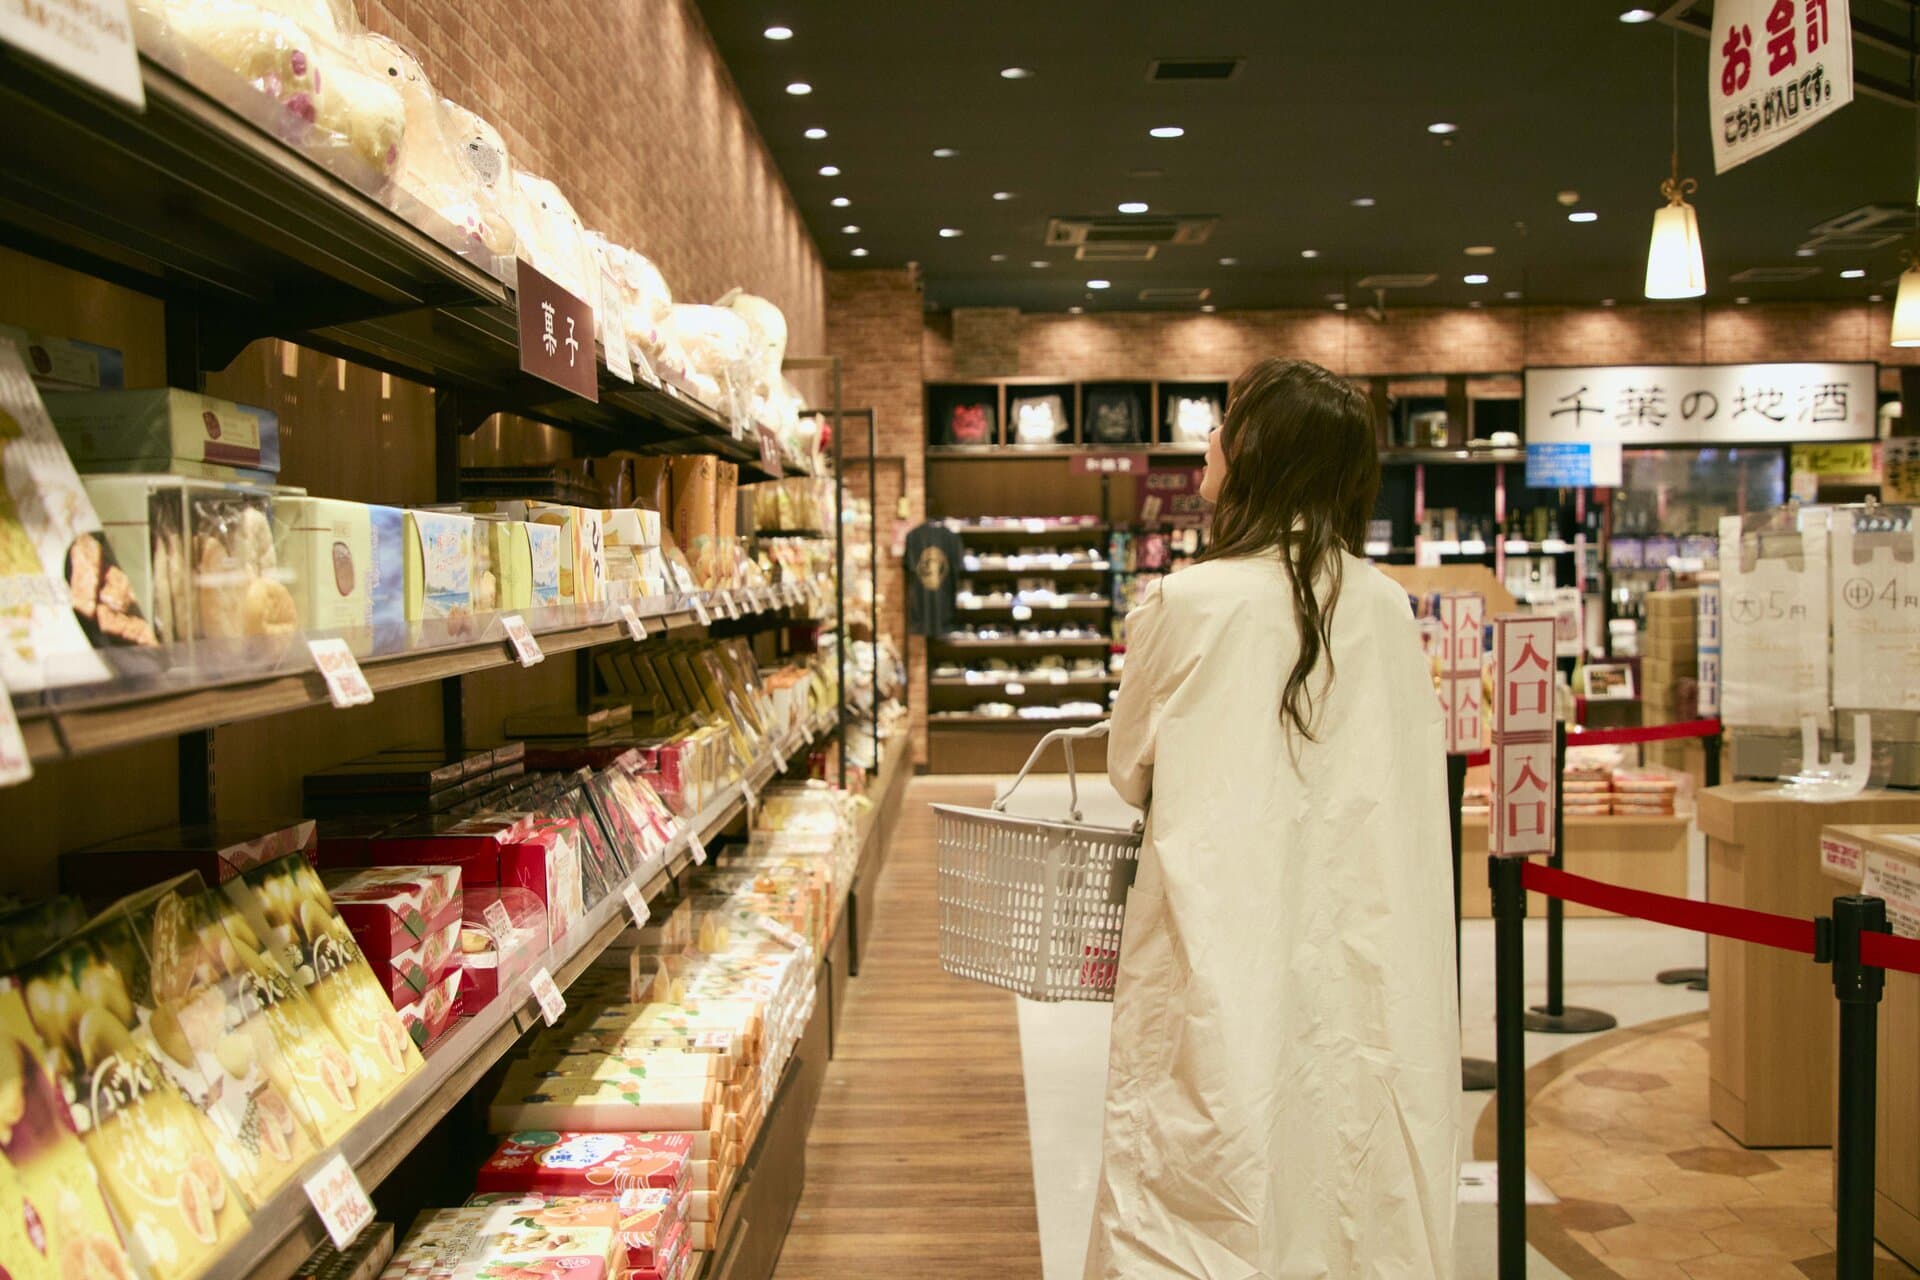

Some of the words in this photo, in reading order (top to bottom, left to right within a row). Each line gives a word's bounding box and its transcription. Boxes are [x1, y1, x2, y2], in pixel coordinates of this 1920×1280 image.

[541, 300, 579, 368] 菓子
[1550, 382, 1850, 428] 千葉の地酒
[1459, 607, 1479, 660] 入口
[1508, 633, 1550, 715] 入口
[1459, 687, 1479, 740] 入口
[1507, 756, 1549, 837] 入口
